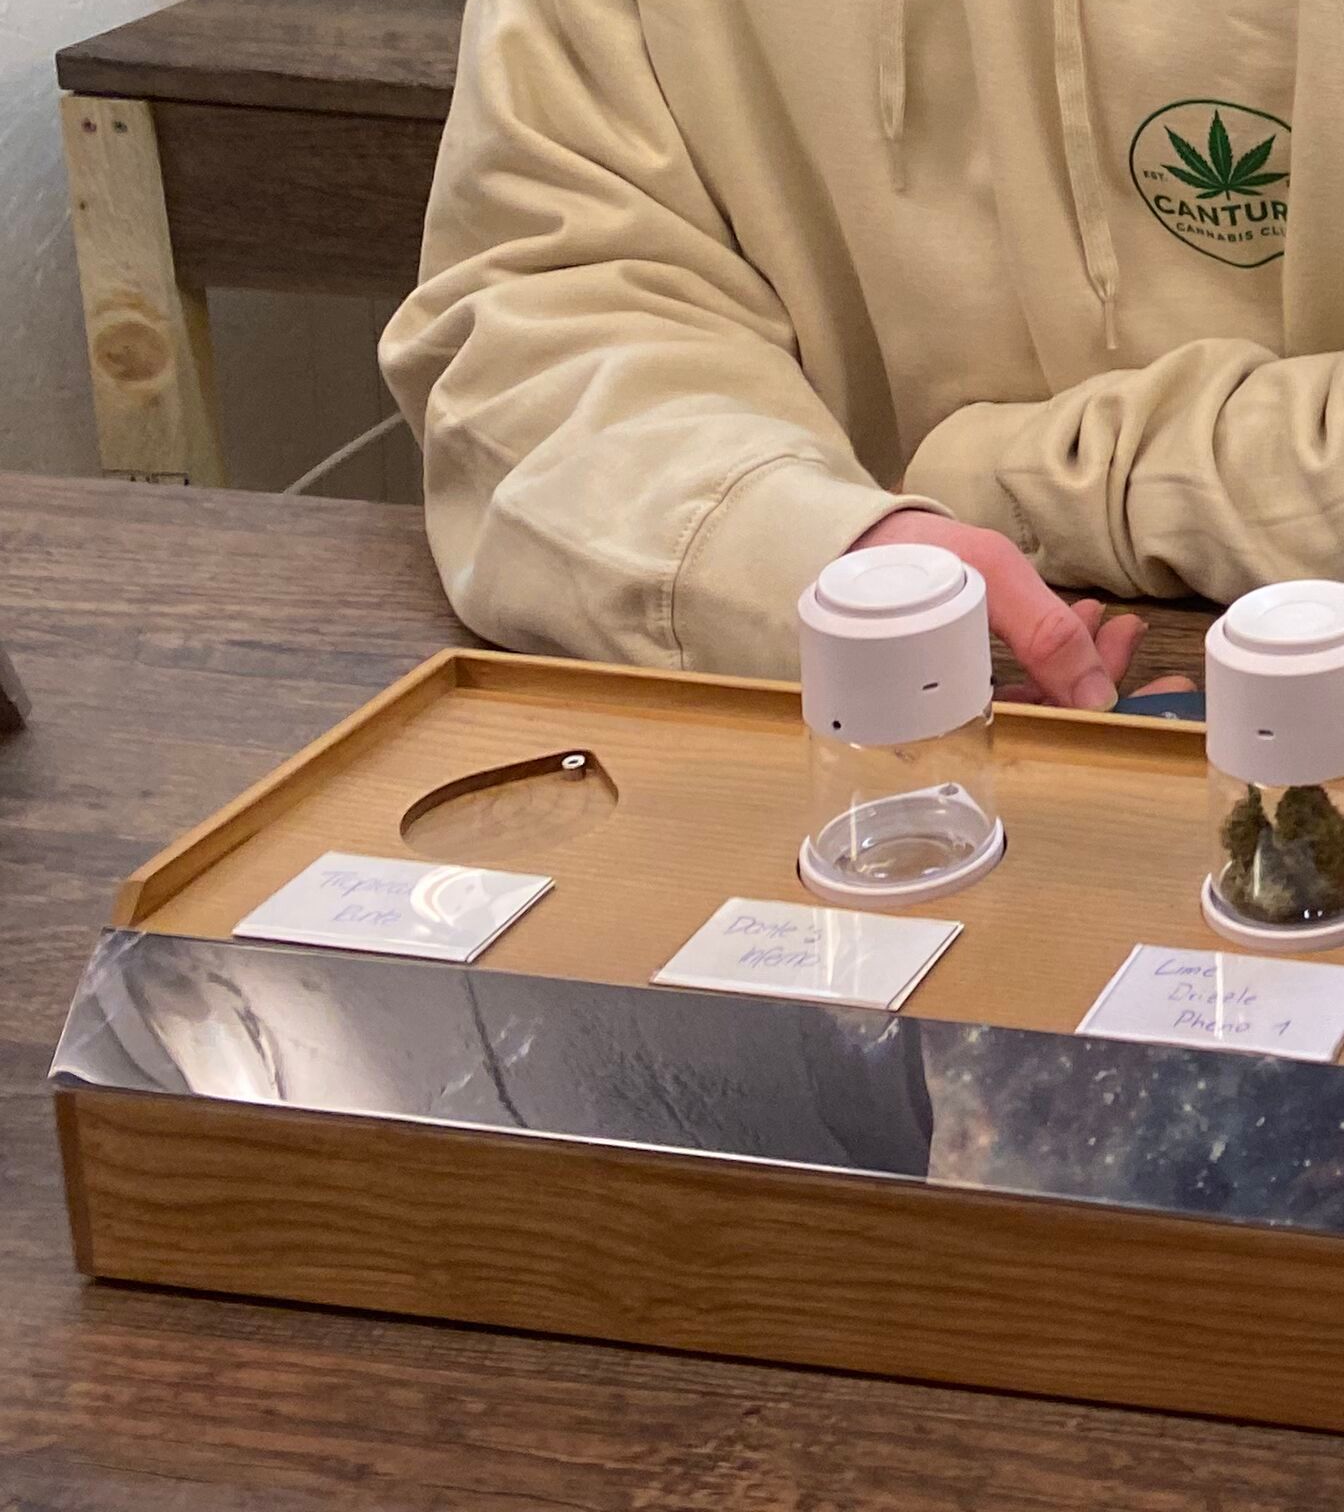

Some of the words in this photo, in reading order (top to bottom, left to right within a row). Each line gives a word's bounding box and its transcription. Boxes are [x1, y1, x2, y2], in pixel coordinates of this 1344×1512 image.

[1144, 170, 1169, 182] EST.
[1154, 195, 1288, 227] CANTUR
[1176, 222, 1254, 243] CANNABIS
